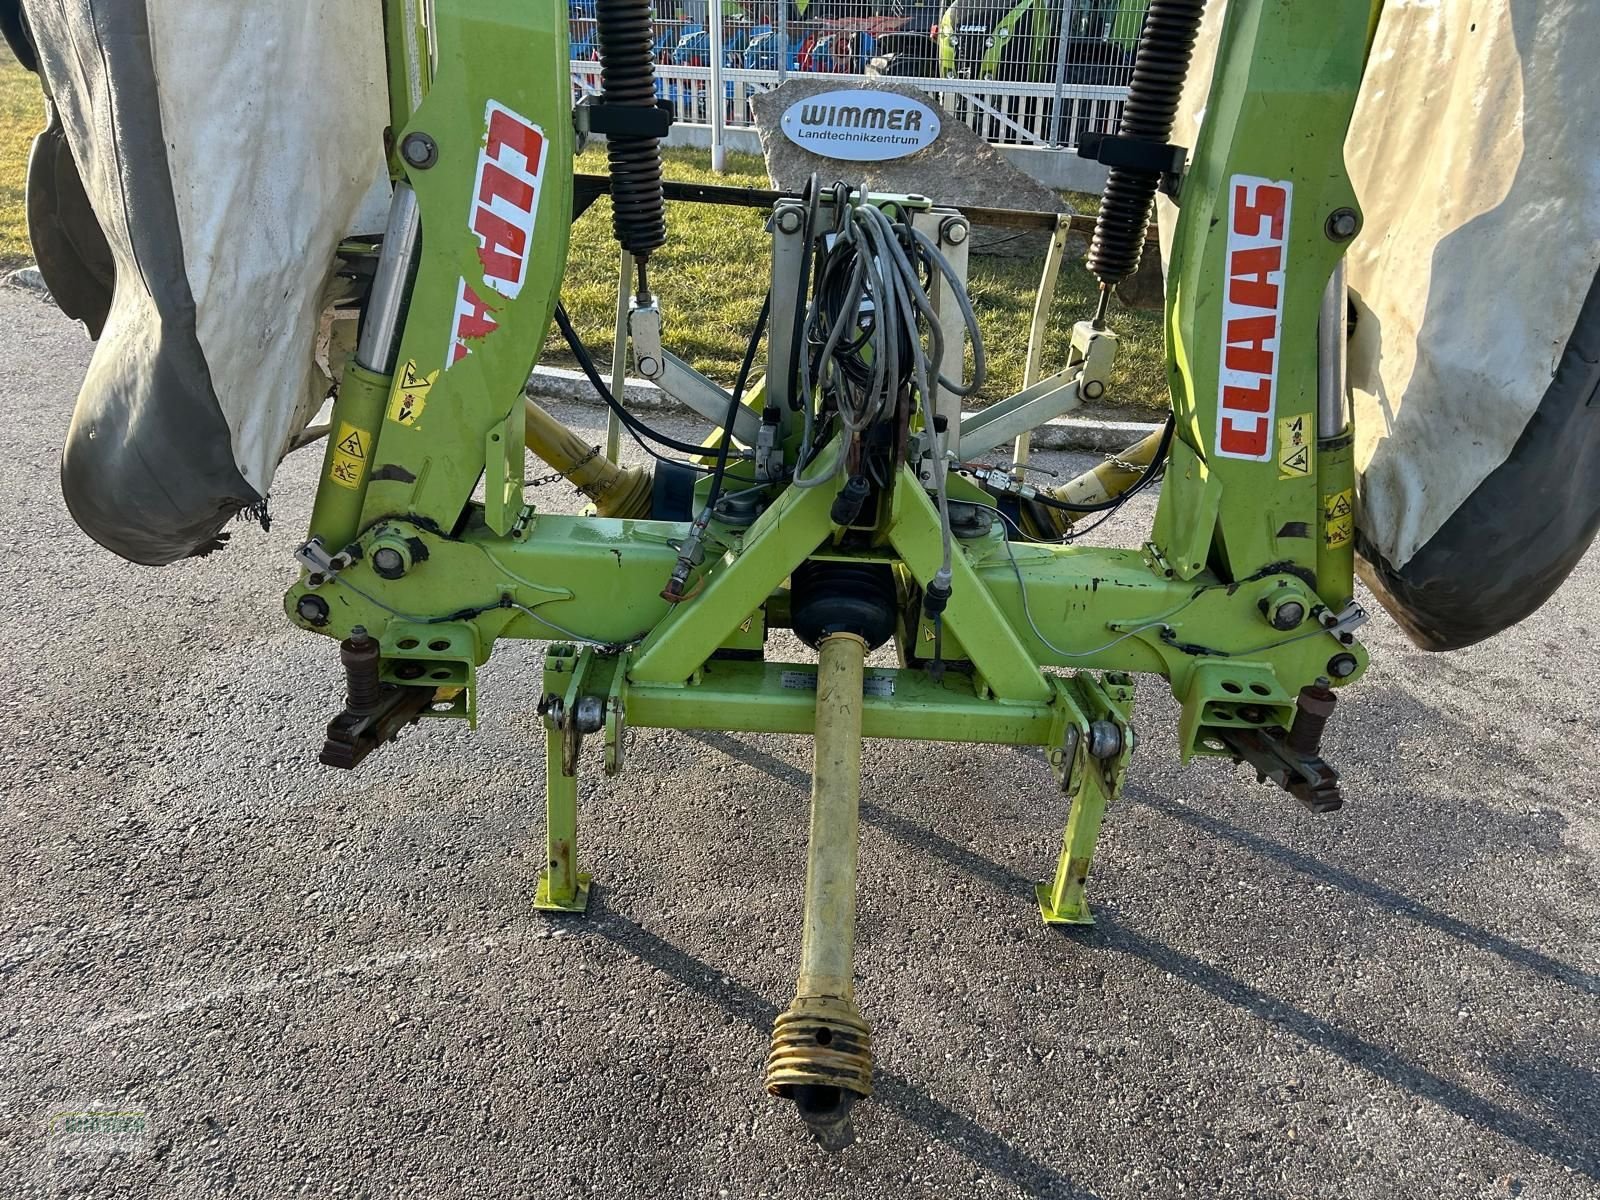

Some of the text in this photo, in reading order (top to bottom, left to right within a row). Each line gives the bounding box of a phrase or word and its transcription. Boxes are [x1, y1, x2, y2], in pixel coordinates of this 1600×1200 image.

[798, 128, 919, 145] Landtechnikzentrum
[800, 104, 923, 132] WIMMER
[453, 109, 544, 364] CLAA
[1220, 184, 1287, 456] CLAAS
